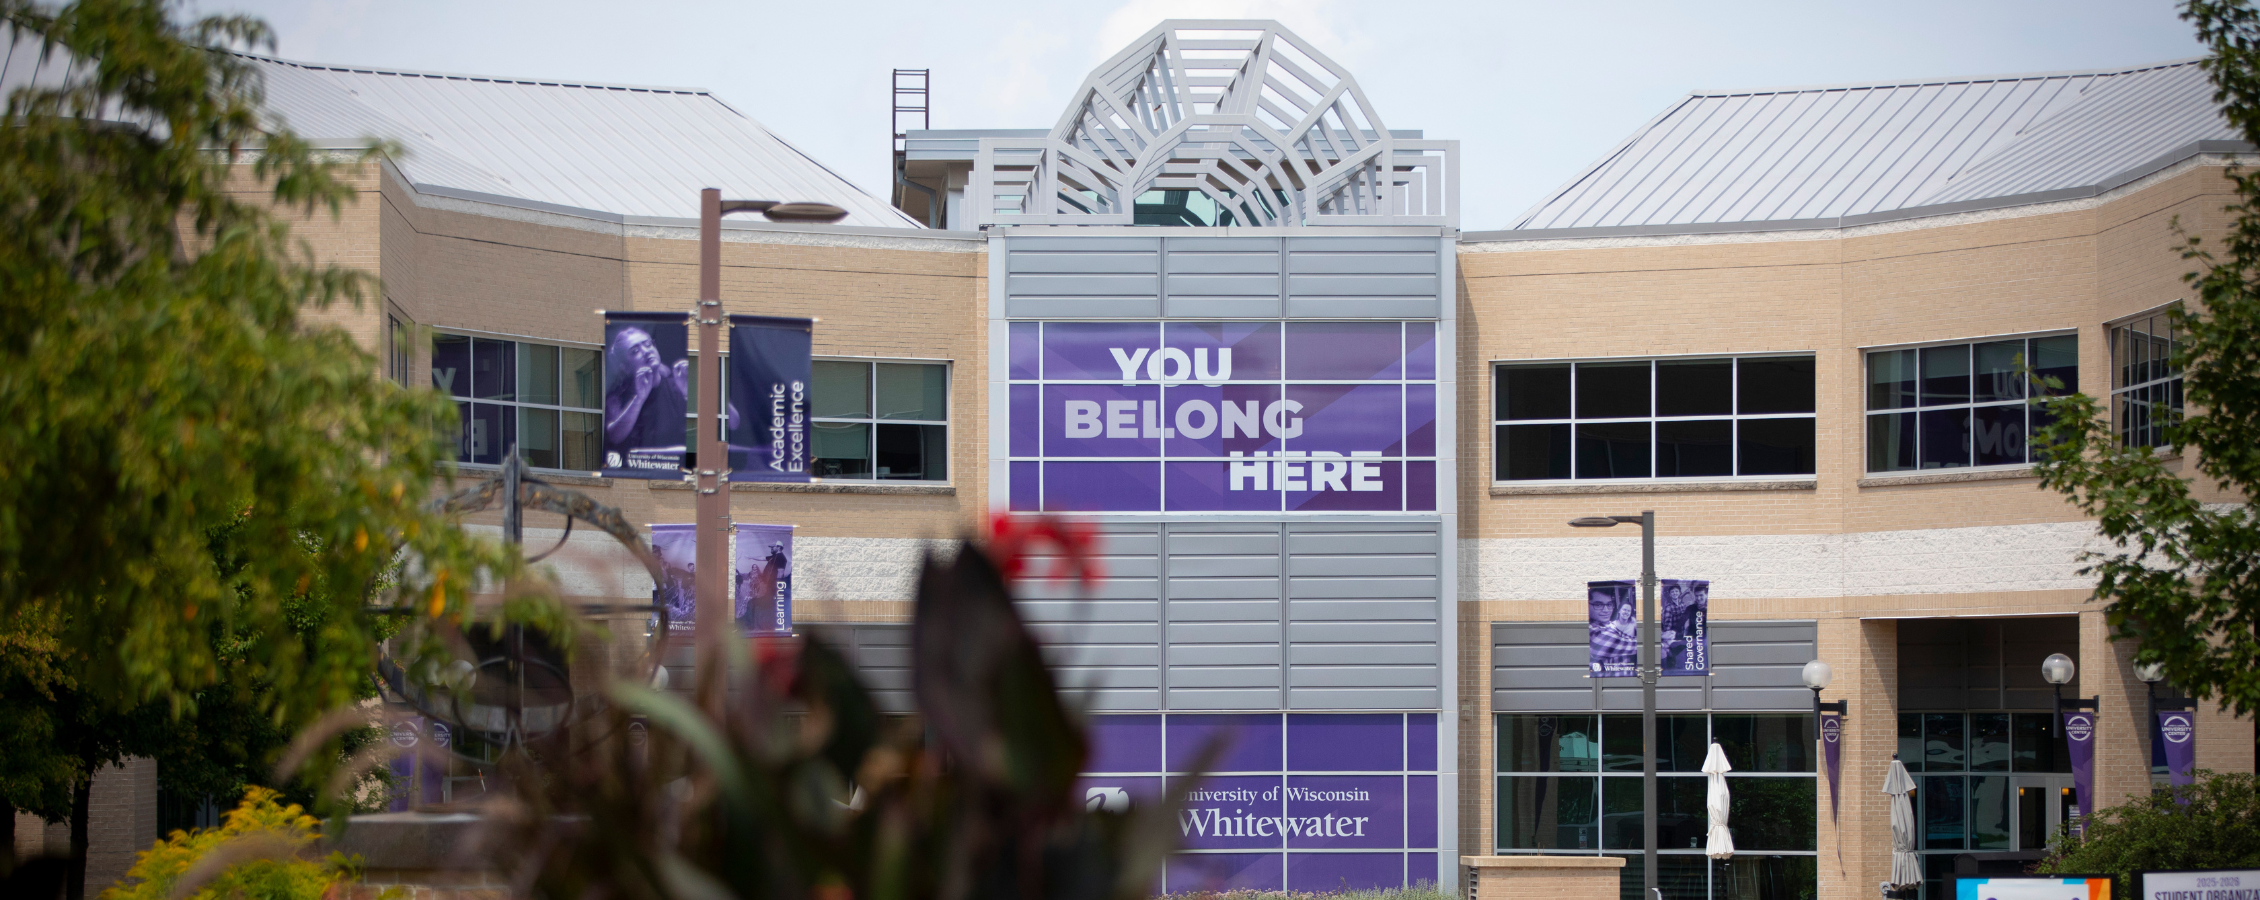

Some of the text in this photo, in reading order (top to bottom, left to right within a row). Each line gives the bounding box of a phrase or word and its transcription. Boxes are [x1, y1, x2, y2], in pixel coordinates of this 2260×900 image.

[1109, 347, 1232, 387] YOU
[769, 383, 785, 472] Academic
[788, 381, 804, 472] Excellence
[1065, 399, 1304, 439] BELONG
[628, 460, 680, 470] Whitewater
[1229, 451, 1383, 491] HERE
[774, 581, 787, 631] Learning
[1684, 635, 1694, 670] Shared
[1695, 611, 1705, 670] Governance
[1262, 786, 1280, 801] of
[1286, 787, 1370, 801] Wisconsin
[1178, 808, 1369, 837] Whitewater
[2155, 889, 2260, 900] STUDENT ORGANIZA
[2197, 877, 2240, 888] 2025-2026
